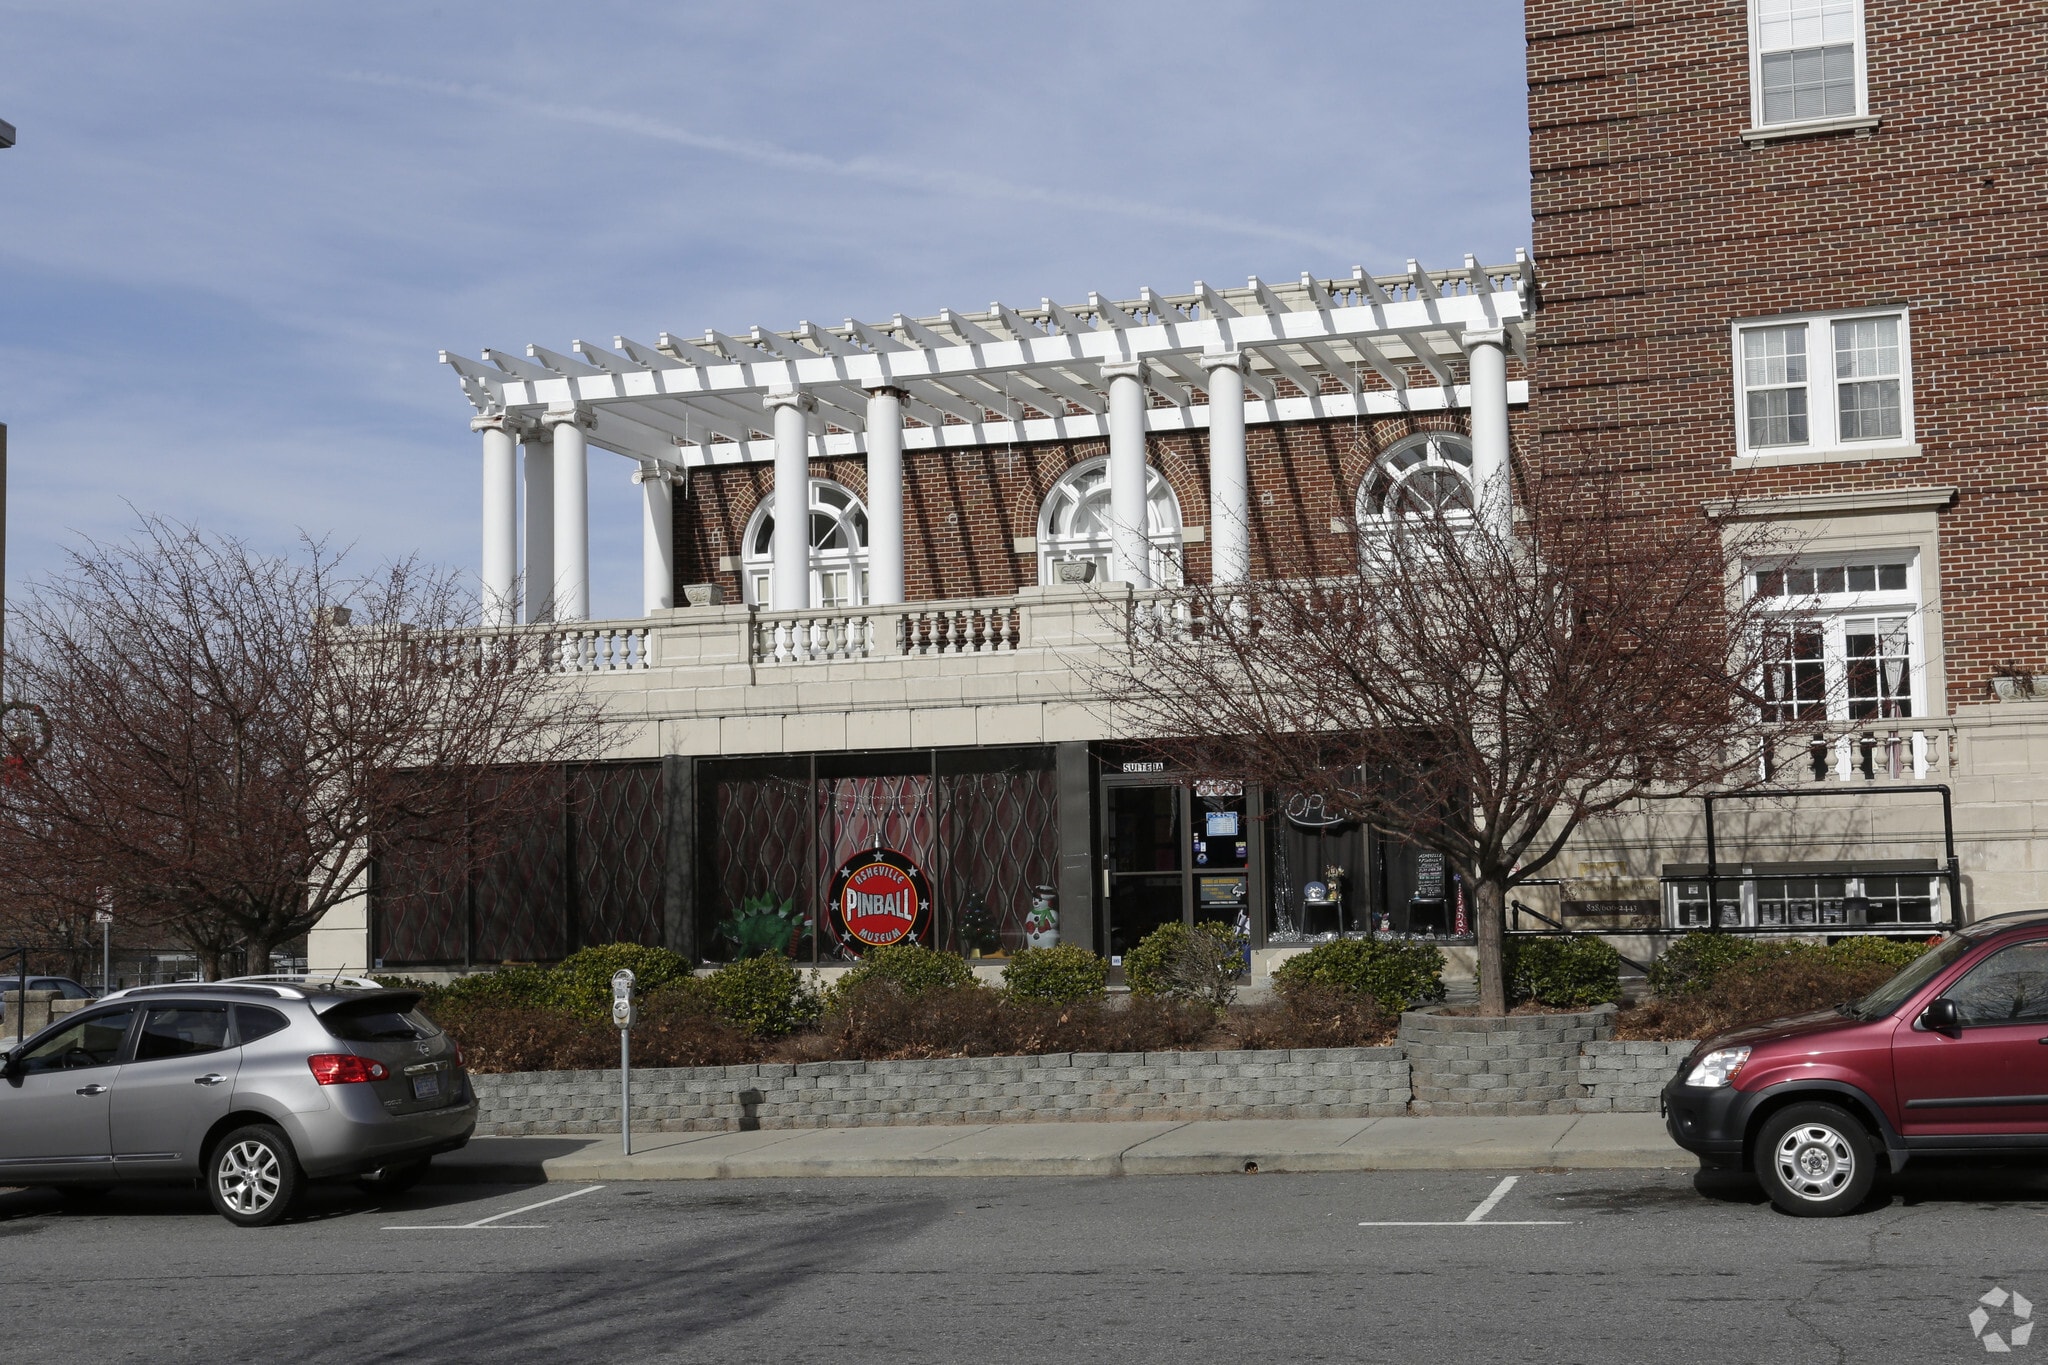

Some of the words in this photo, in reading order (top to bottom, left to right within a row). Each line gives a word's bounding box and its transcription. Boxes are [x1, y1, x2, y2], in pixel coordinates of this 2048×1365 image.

[1123, 763, 1151, 772] SUITE
[1289, 792, 1352, 819] OP
[855, 866, 905, 884] ASHEVILLE
[846, 887, 912, 922] PINBALL
[859, 928, 902, 942] MUSEUM
